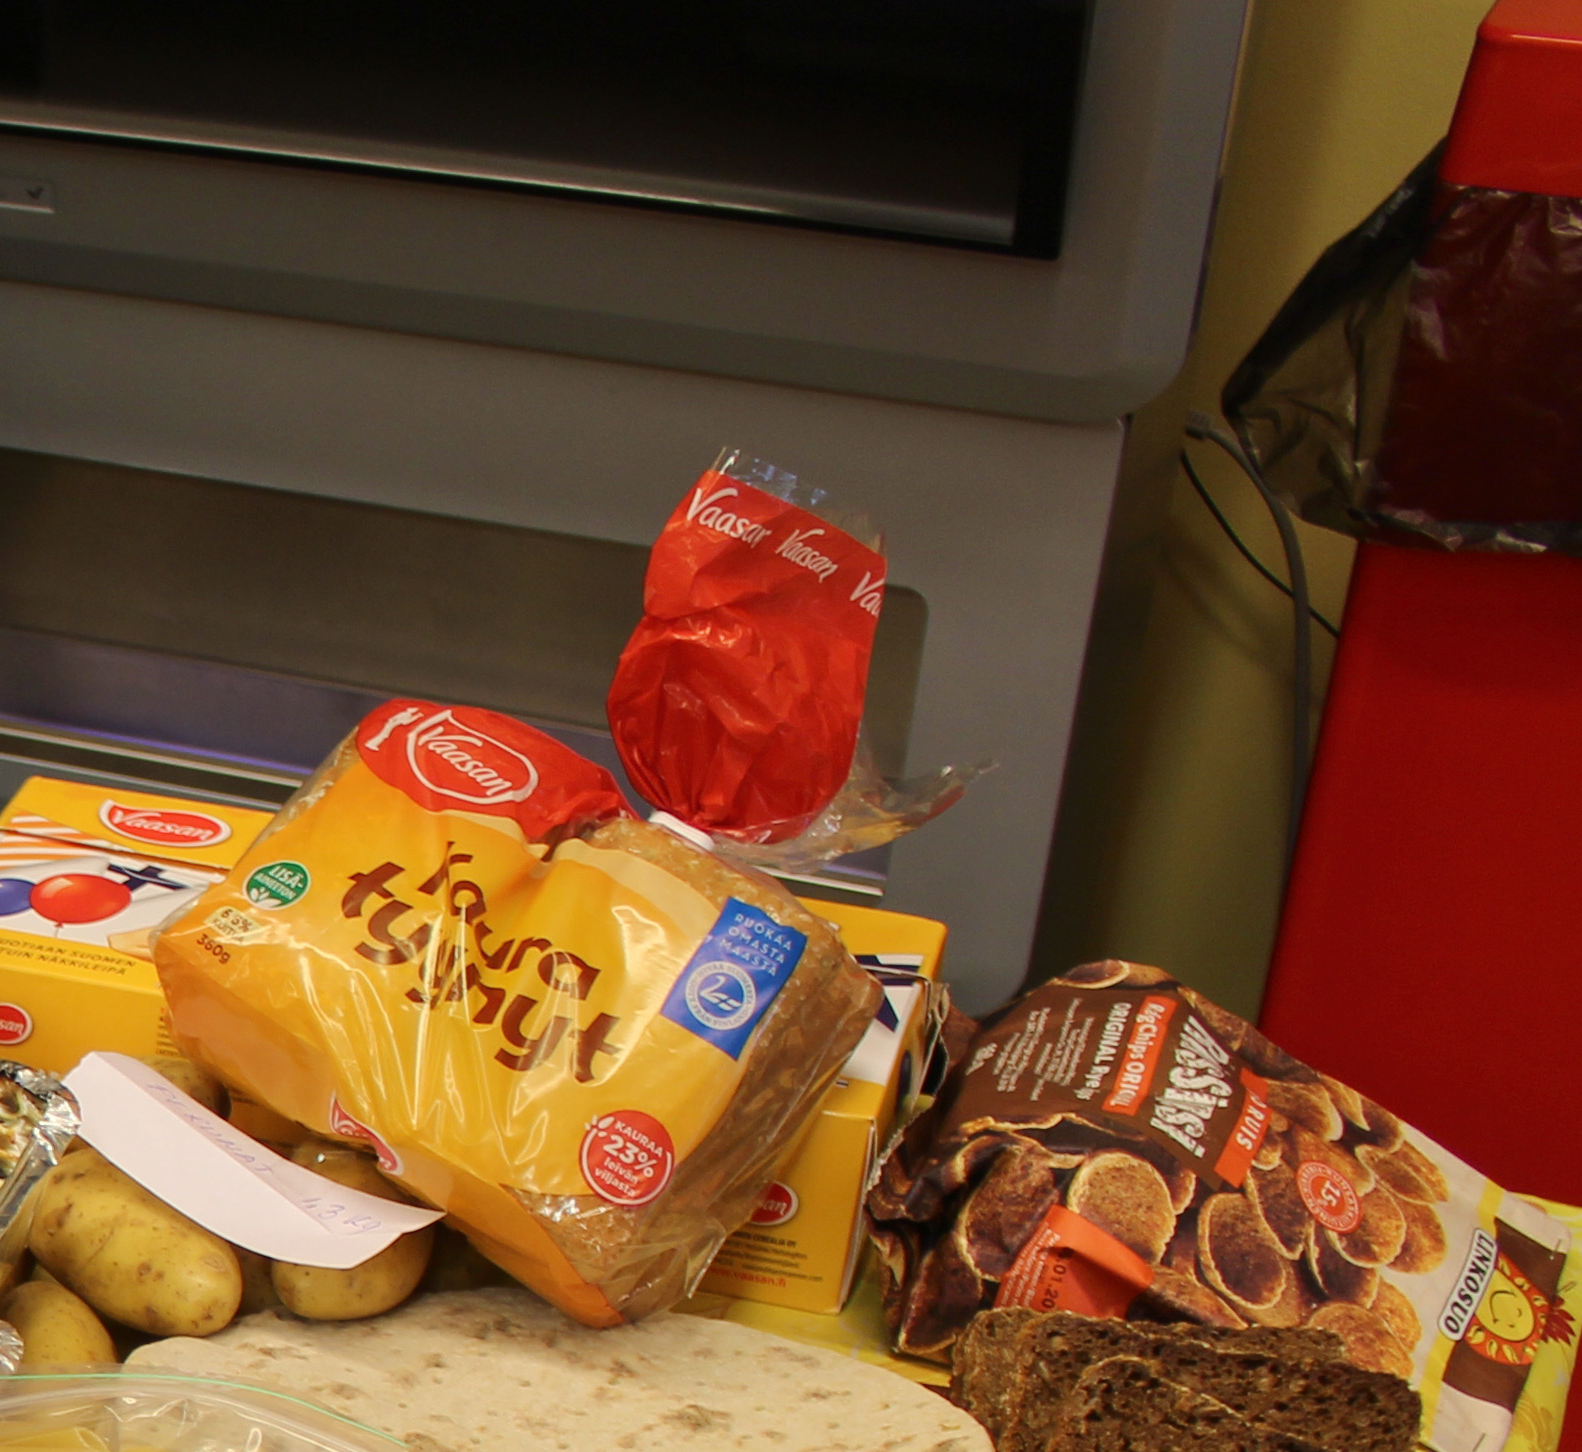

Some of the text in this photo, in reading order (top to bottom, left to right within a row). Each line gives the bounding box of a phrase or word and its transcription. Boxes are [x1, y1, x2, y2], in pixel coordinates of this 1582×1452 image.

[418, 725, 514, 798] Vaasan
[111, 803, 218, 843] Vaasan
[727, 926, 786, 964] OMASTA
[733, 912, 793, 952] RUOKAA
[40, 950, 128, 976] NÄKKILEIPÄ
[65, 948, 137, 969] SUOMEN
[718, 938, 777, 977] MAASTA
[602, 1133, 659, 1179] 23%
[614, 1118, 664, 1159] KAURAA
[593, 1166, 637, 1200] viljasta
[603, 1155, 641, 1187] leivän
[1444, 1231, 1495, 1336] LINKOSUO
